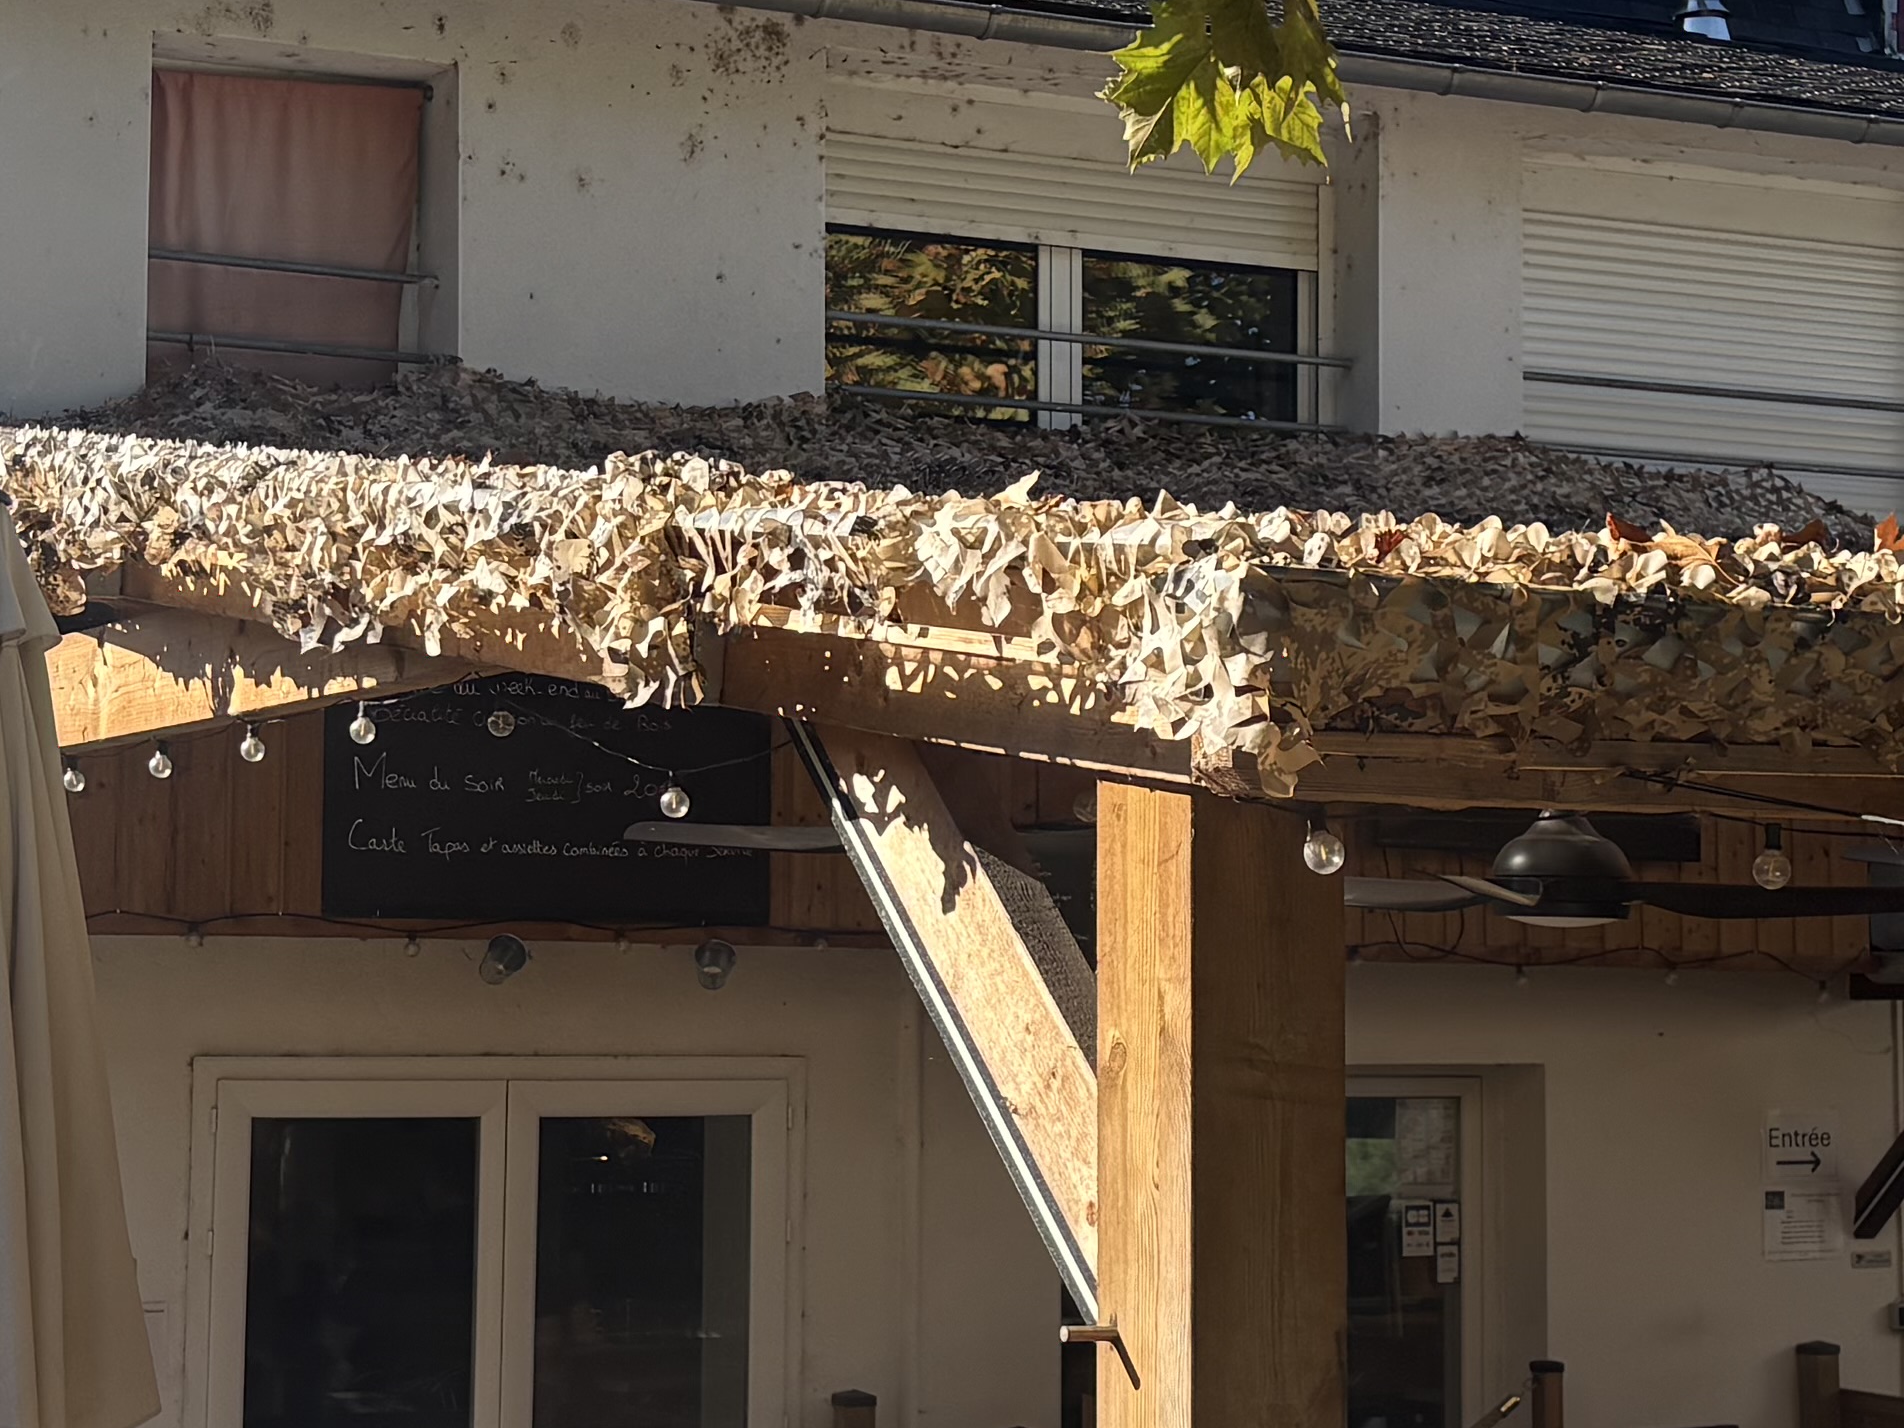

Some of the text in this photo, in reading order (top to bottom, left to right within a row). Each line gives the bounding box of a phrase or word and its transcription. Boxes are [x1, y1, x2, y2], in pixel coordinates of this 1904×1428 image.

[353, 751, 417, 790] Menu
[429, 765, 451, 791] du
[348, 818, 407, 853] Carte
[420, 826, 471, 861] Tapas
[480, 836, 498, 853] et
[501, 839, 558, 855] assiettes
[637, 840, 648, 857] à
[1768, 1126, 1832, 1149] Entrée
